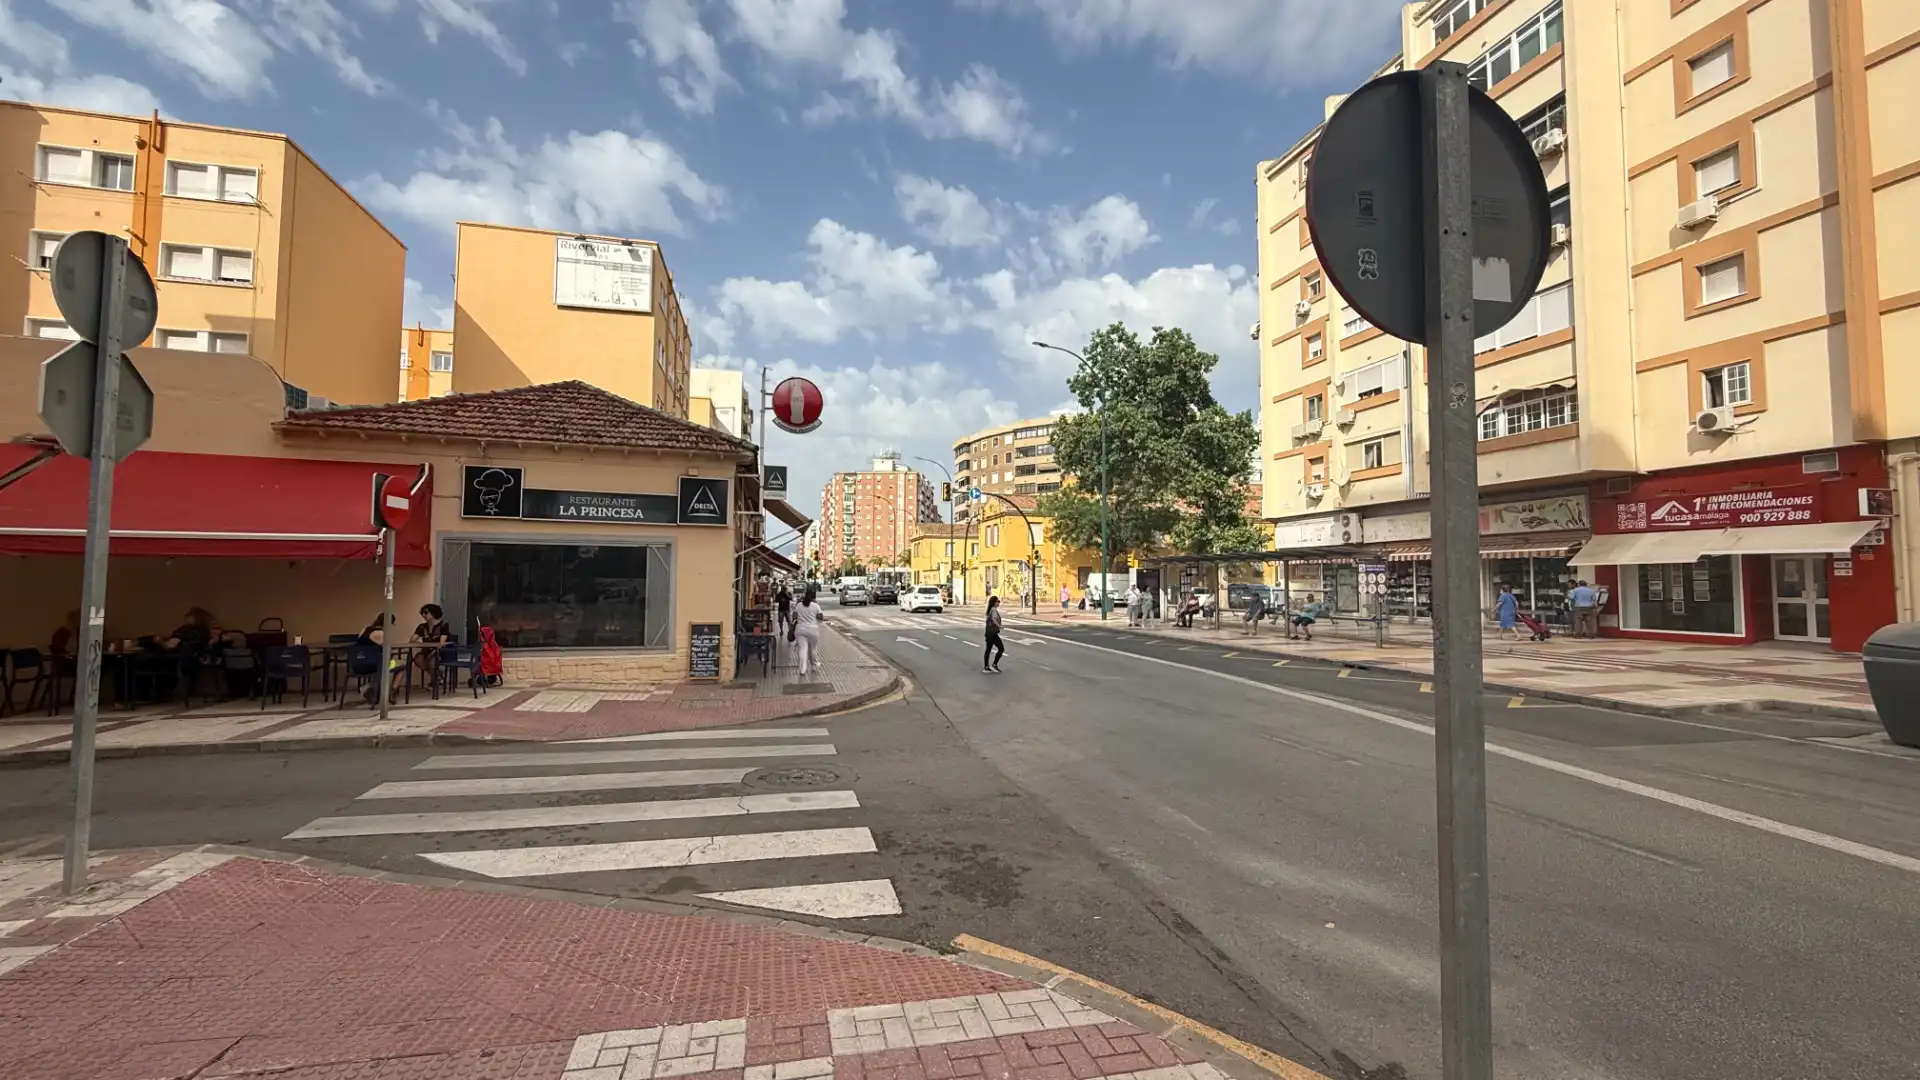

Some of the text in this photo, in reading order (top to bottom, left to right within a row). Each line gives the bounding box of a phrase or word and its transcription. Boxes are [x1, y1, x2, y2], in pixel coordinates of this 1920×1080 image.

[569, 496, 637, 507] RESTAURANTE
[1708, 491, 1773, 503] INMOBILIARIA
[694, 502, 714, 510] DELTA
[1707, 496, 1813, 511] EN RECOMENDACIONES
[559, 505, 645, 519] LA PRINCESA
[1740, 510, 1811, 523] 900 929 888
